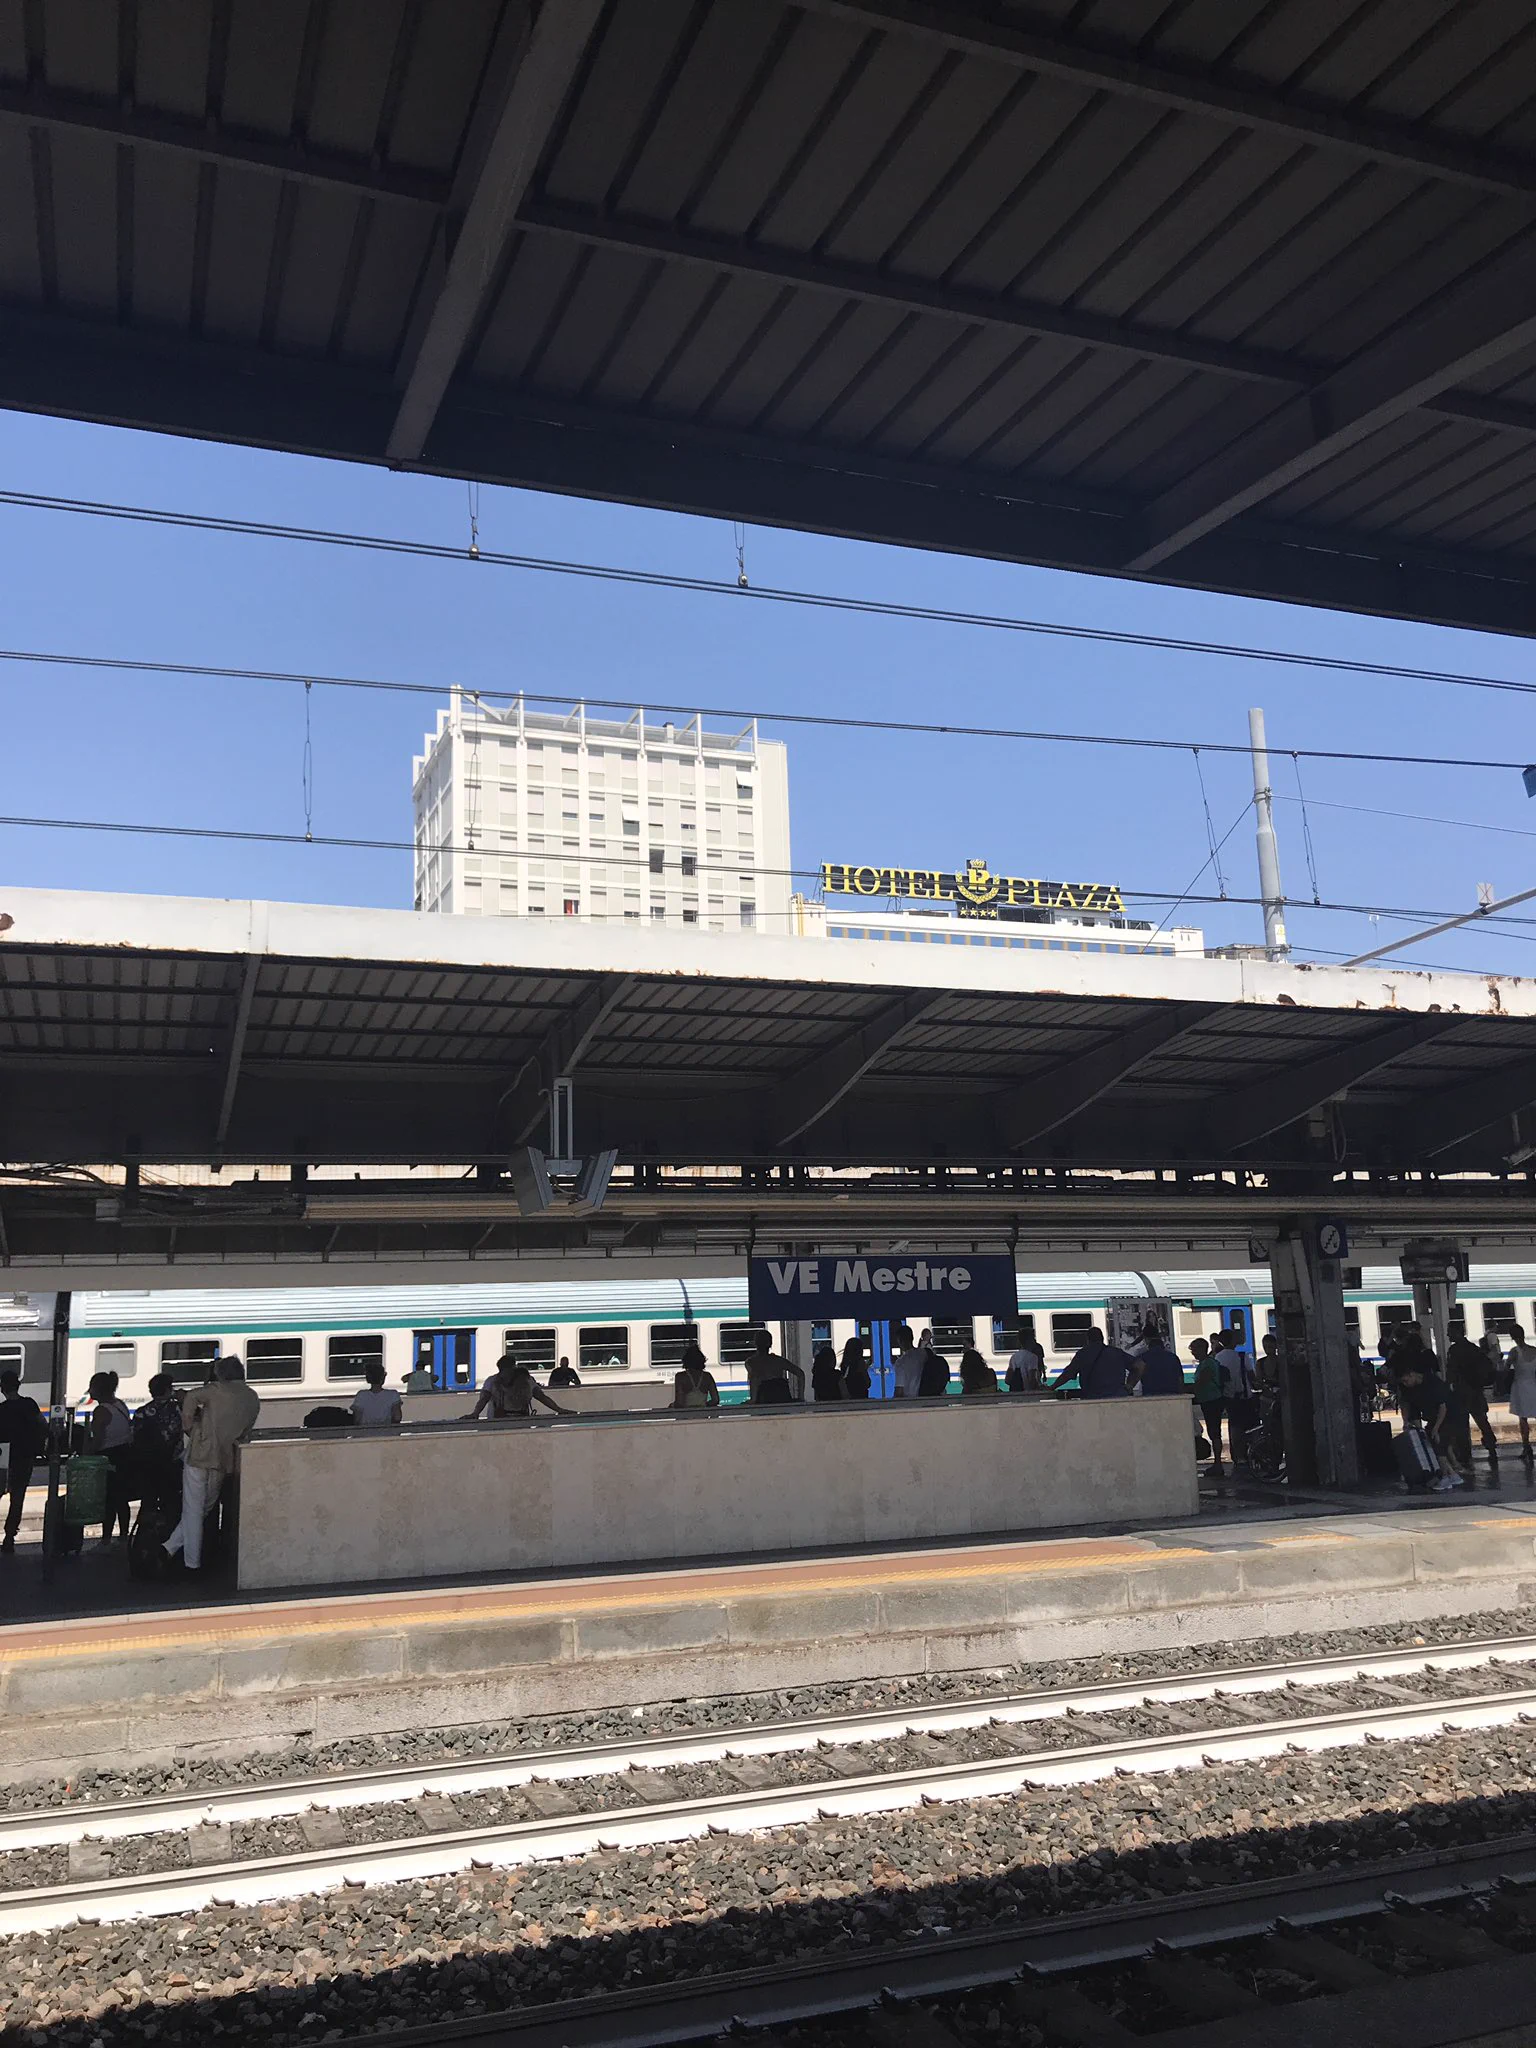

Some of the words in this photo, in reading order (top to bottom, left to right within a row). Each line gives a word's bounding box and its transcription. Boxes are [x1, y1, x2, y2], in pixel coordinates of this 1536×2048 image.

[822, 862, 954, 901] HOTEL
[1005, 876, 1127, 912] PLAZA
[766, 1261, 820, 1294] VE
[833, 1260, 972, 1293] Mestre
